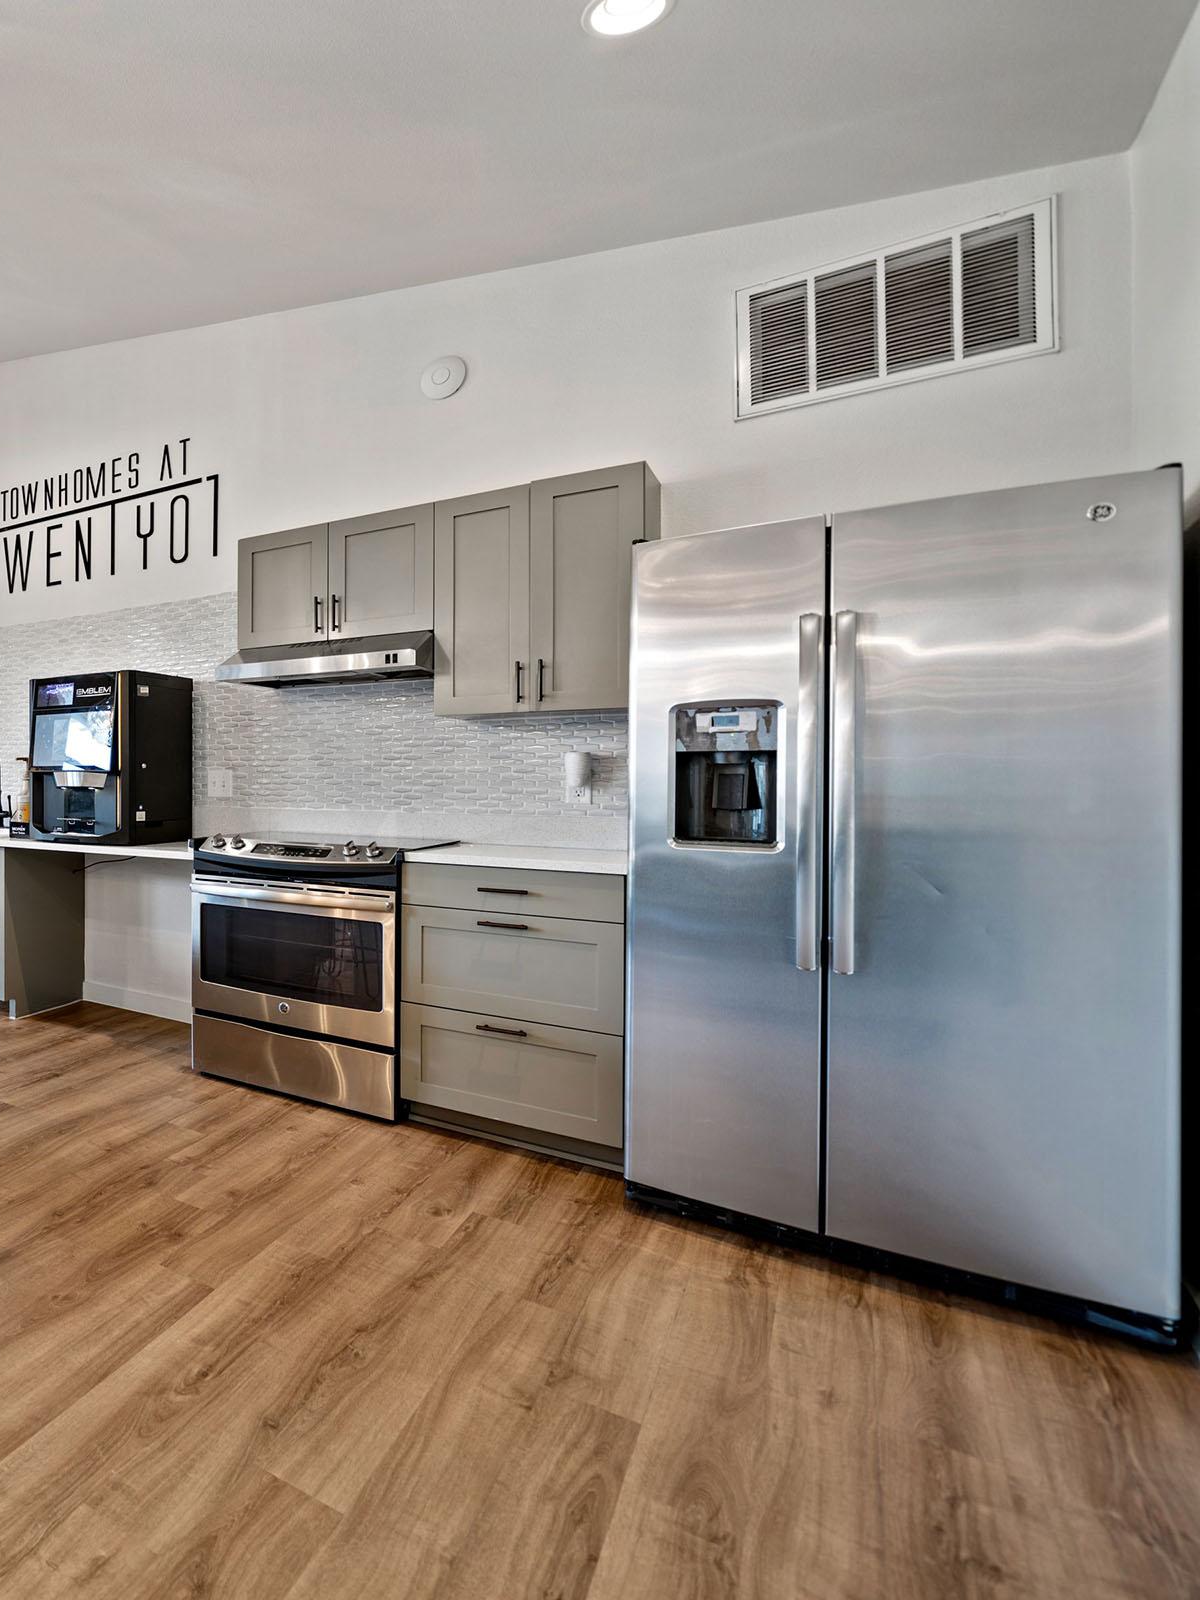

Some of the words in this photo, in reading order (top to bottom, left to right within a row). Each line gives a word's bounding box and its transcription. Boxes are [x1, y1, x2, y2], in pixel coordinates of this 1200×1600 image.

[1, 453, 139, 521] TOWNHOMES
[160, 438, 190, 481] AT
[76, 686, 112, 696] EMBLEM
